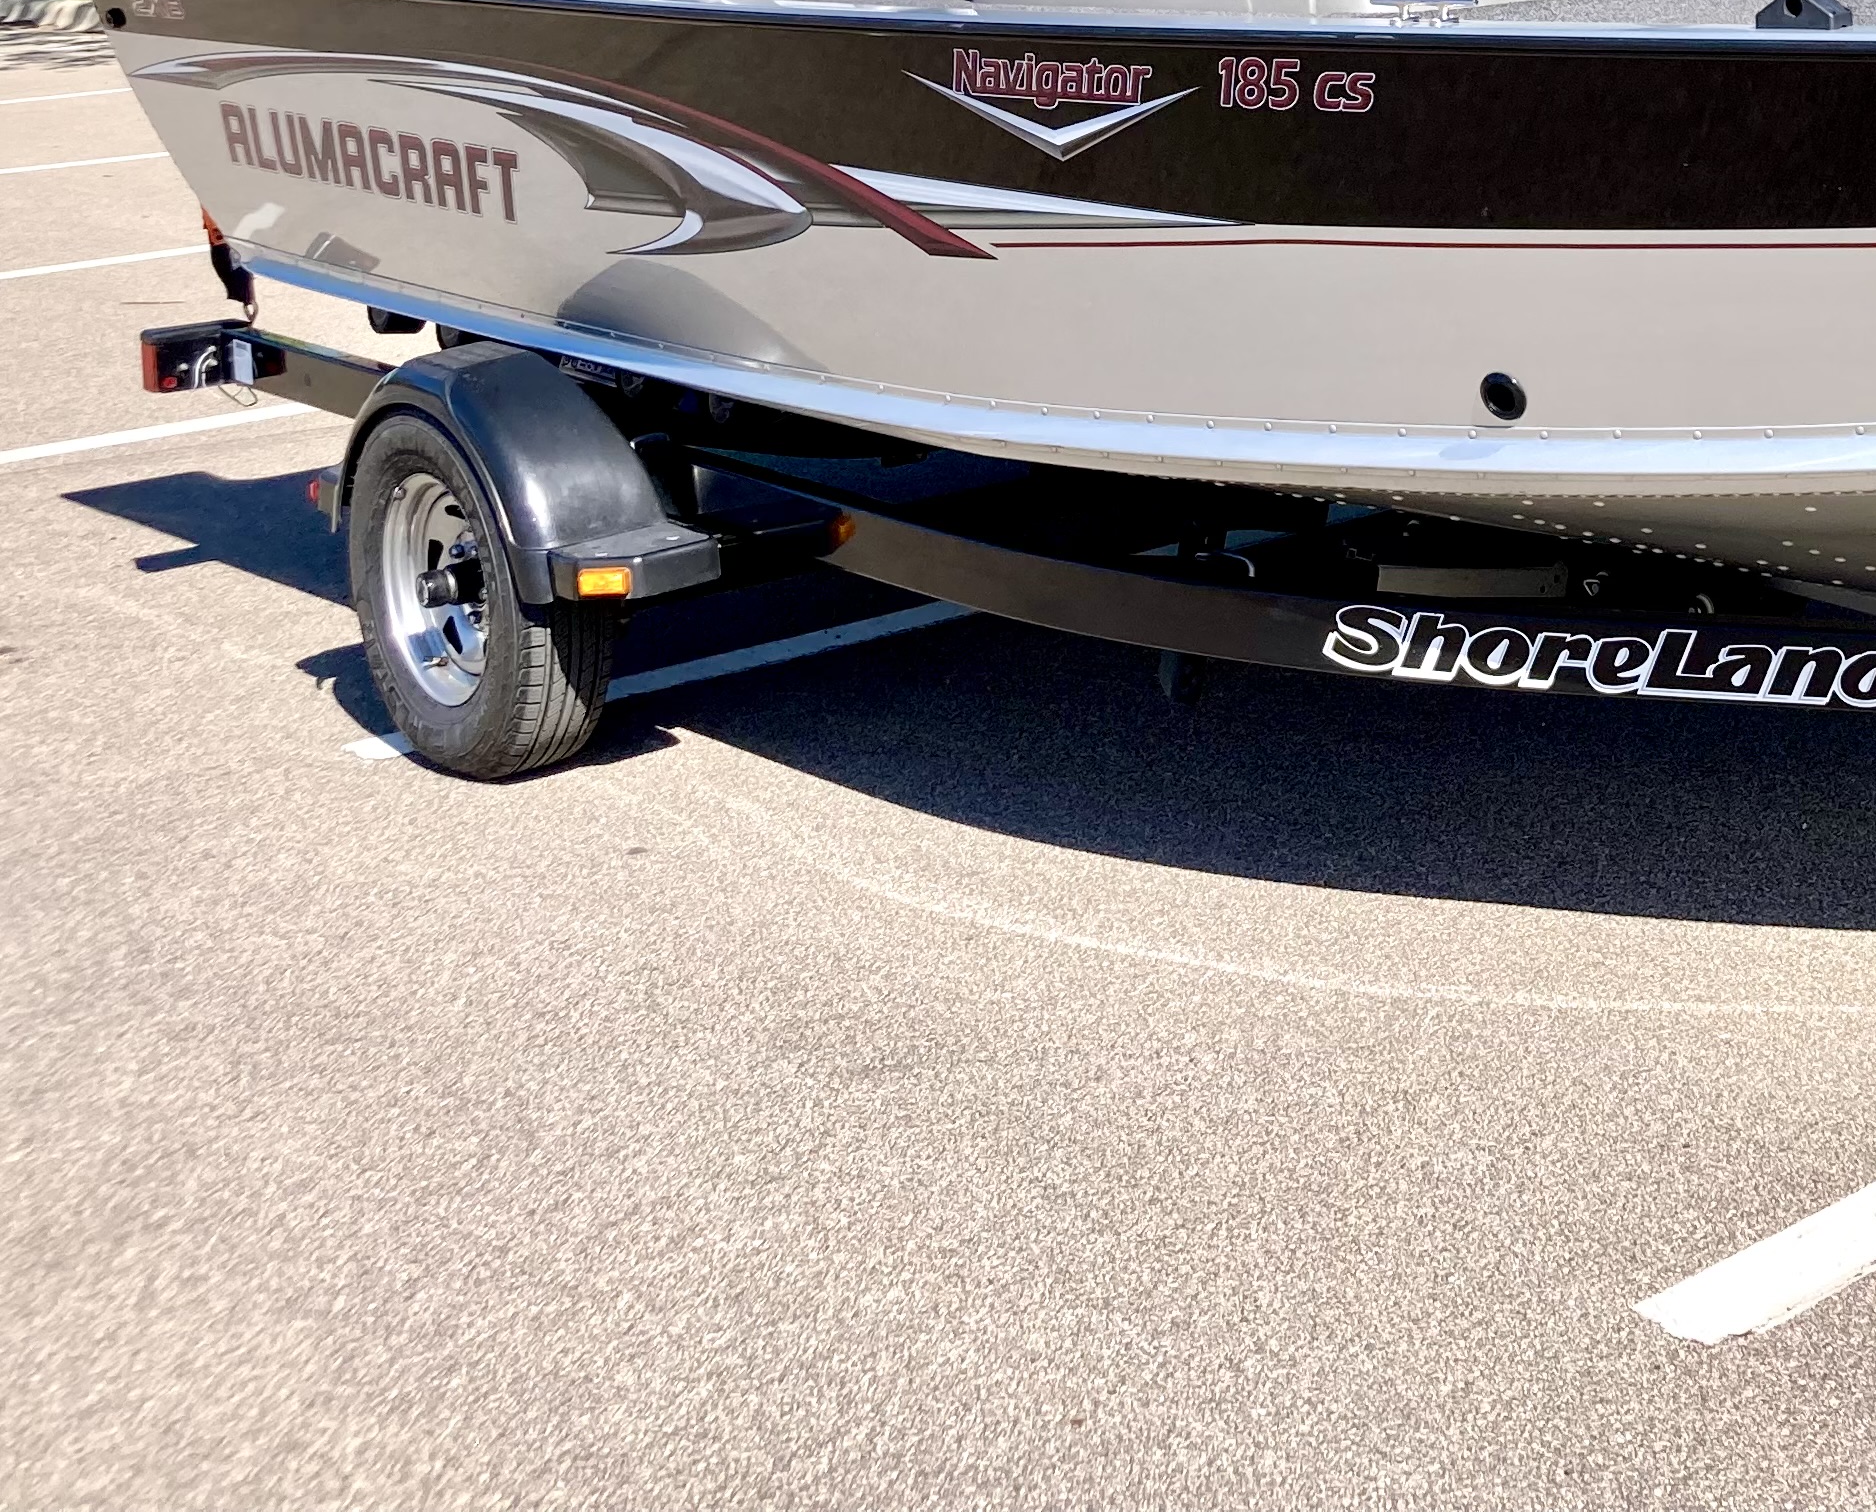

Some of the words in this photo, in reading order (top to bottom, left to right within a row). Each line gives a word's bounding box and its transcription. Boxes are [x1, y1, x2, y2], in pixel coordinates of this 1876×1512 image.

[951, 47, 1153, 110] Navigator
[1217, 56, 1301, 111] 185
[219, 100, 520, 224] ALUMACRAFT
